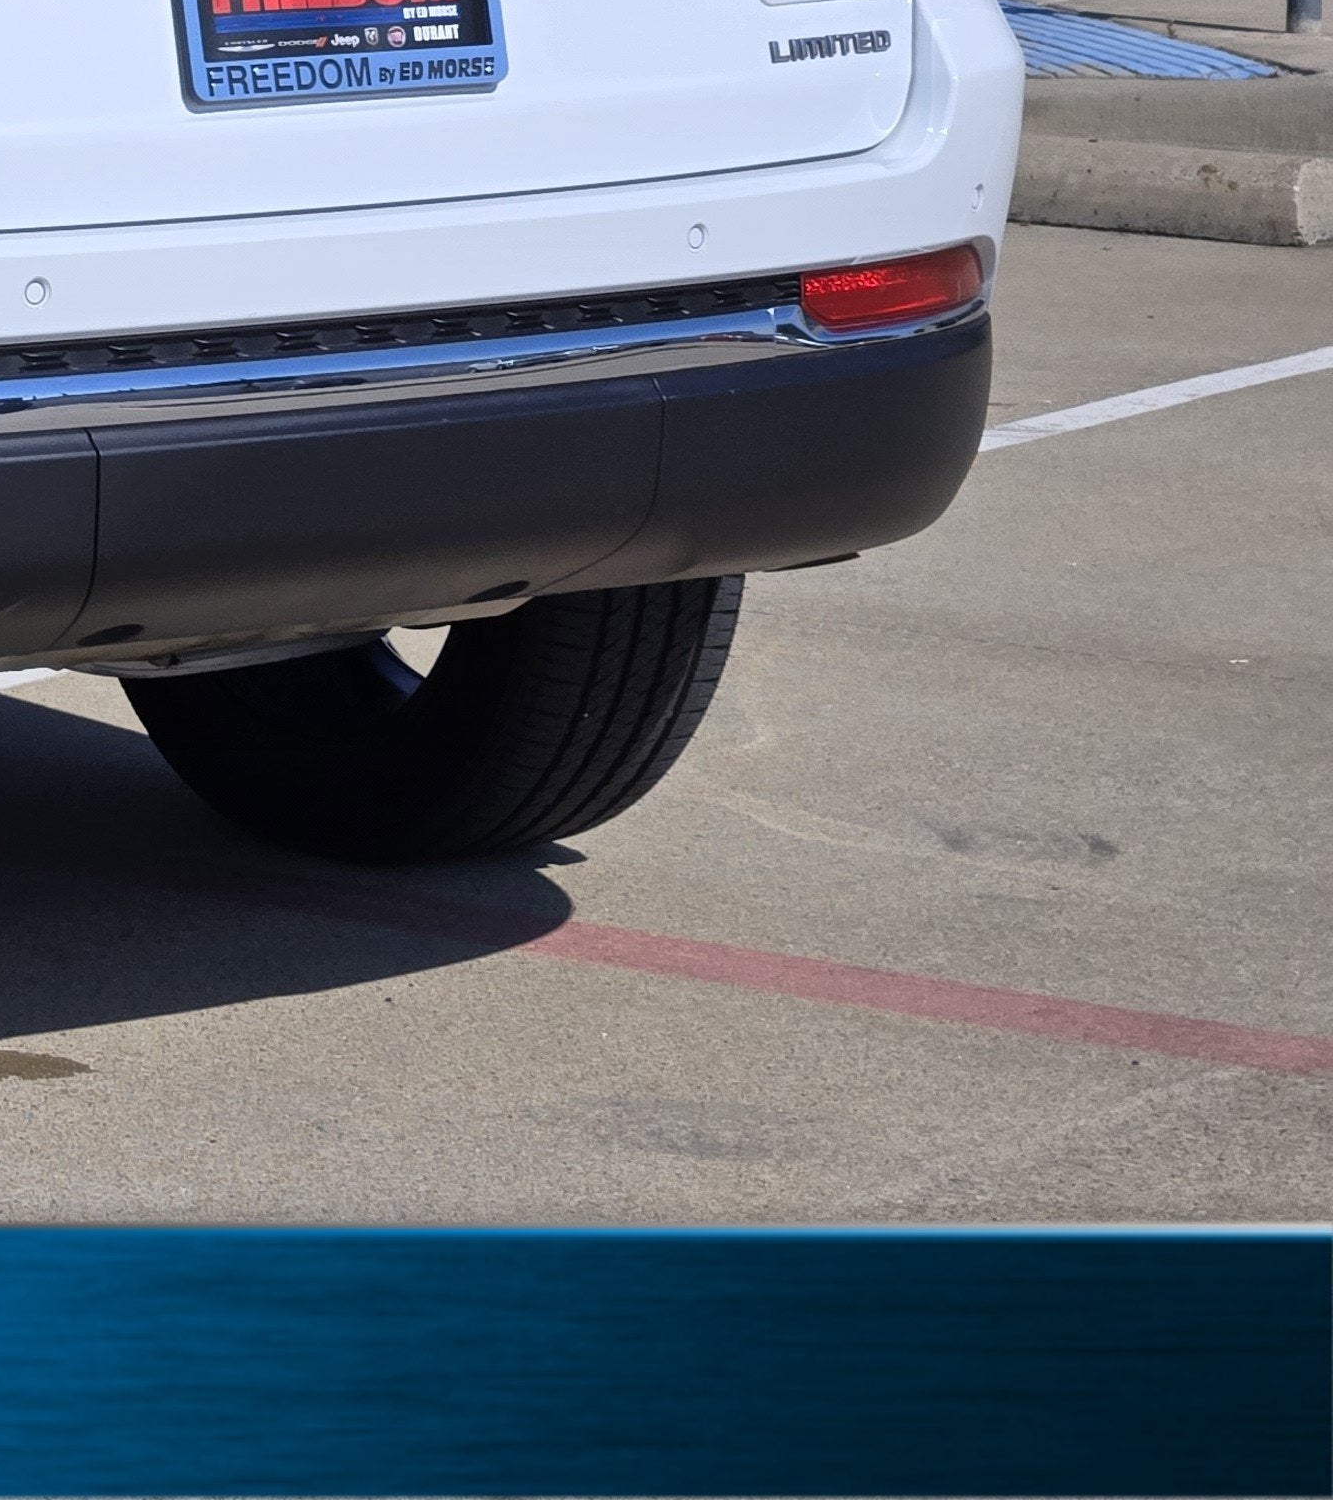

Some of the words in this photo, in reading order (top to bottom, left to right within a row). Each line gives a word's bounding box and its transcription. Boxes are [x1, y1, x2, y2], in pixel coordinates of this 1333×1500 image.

[402, 7, 416, 20] BY
[416, 6, 429, 19] ED
[428, 5, 459, 18] MORSE
[331, 33, 361, 48] Jeep
[413, 23, 460, 42] DURANT
[768, 30, 892, 64] LIMITED
[206, 56, 372, 98] FREEDOM
[399, 61, 424, 82] ED
[427, 56, 495, 80] MORSE
